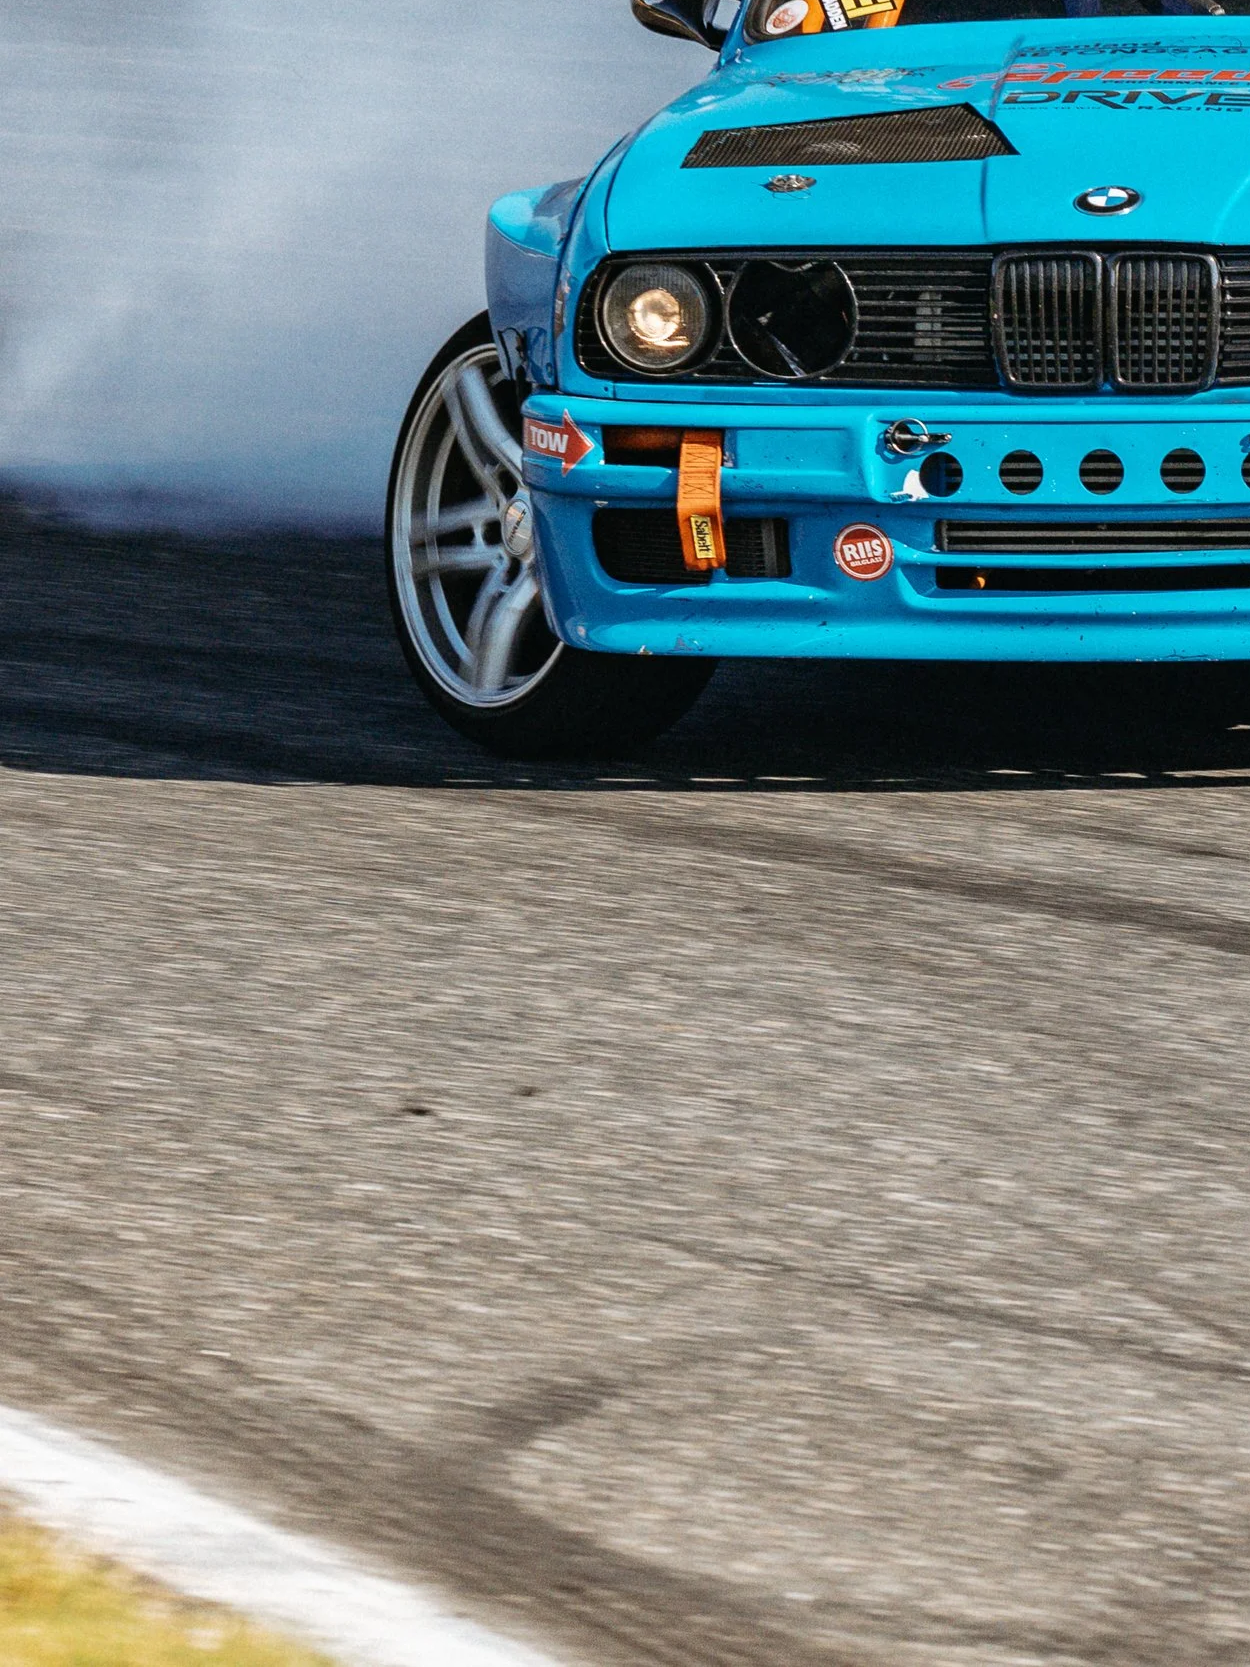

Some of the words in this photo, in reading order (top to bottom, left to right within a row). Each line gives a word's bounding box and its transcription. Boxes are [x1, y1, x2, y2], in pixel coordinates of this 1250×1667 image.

[1138, 105, 1243, 113] RACING
[529, 425, 569, 454] TOW
[842, 539, 883, 561] RIIS
